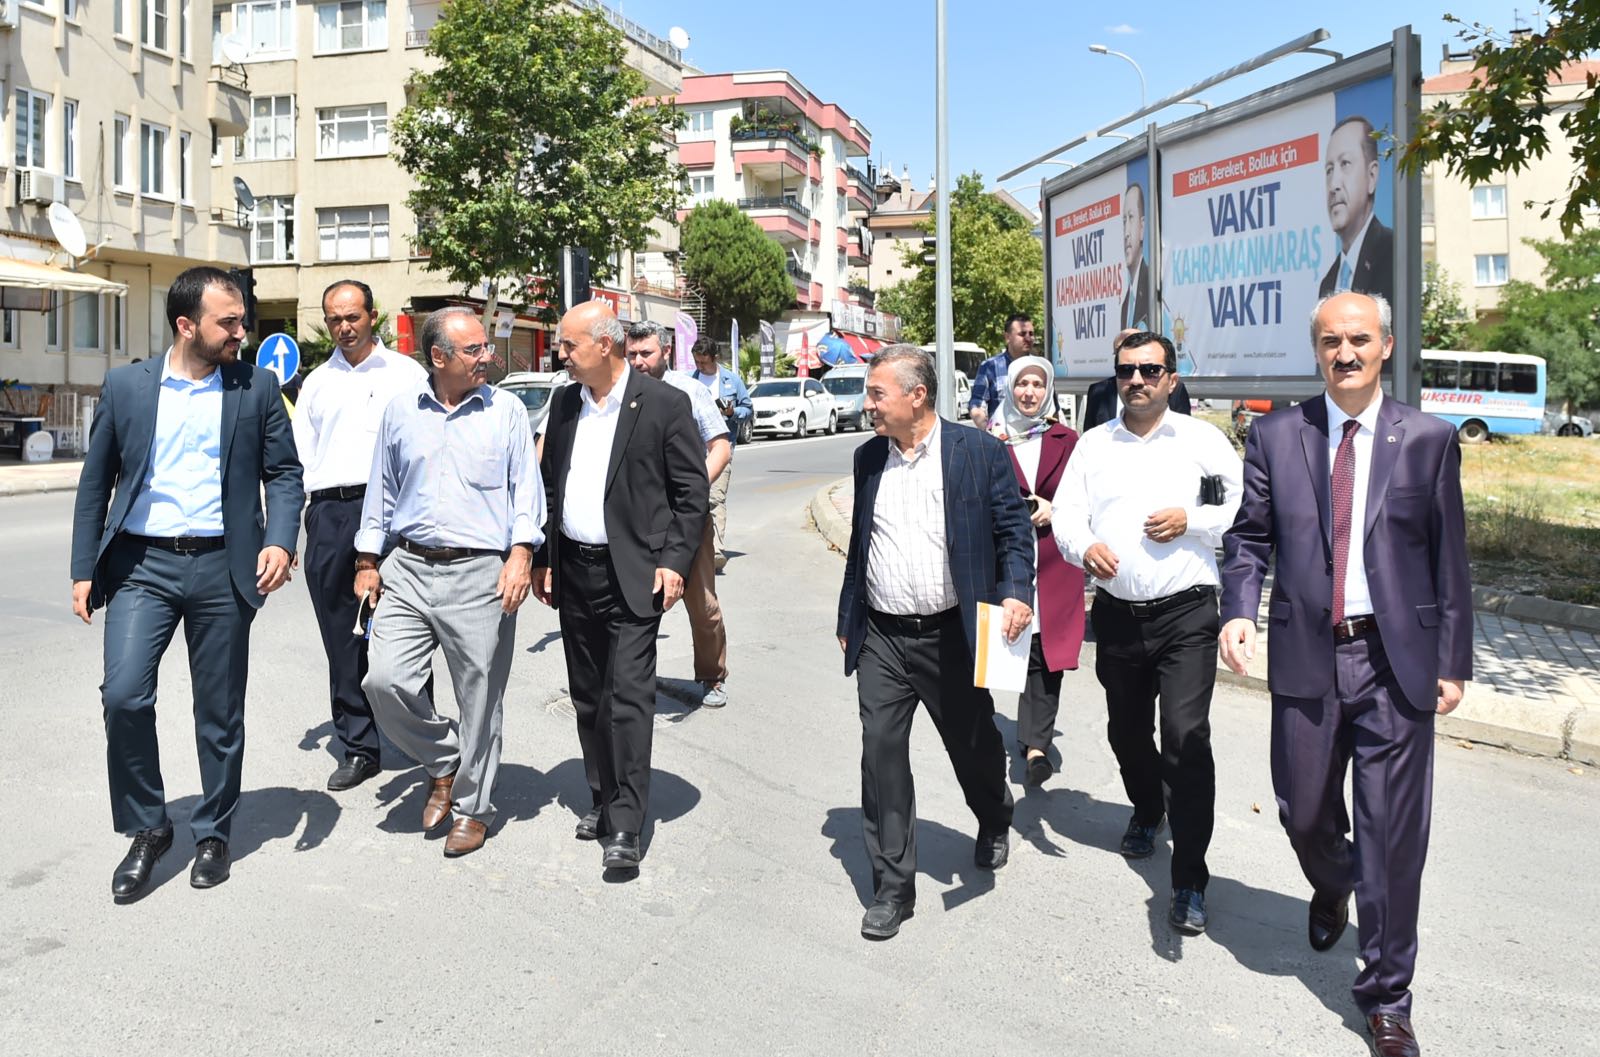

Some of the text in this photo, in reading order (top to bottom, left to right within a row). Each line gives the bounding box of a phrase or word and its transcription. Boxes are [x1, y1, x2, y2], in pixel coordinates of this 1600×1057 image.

[1188, 145, 1297, 188] Birlik, Bereket, Bolluk için
[1208, 181, 1281, 238] VAKİT
[1072, 228, 1105, 270] VAKİT
[1173, 225, 1321, 286] KAHRAMANMARAŞ
[1056, 262, 1122, 308] KAHRAMANMARAŞ
[1208, 280, 1282, 329] VAKTİ
[1072, 304, 1106, 341] VAKTİ
